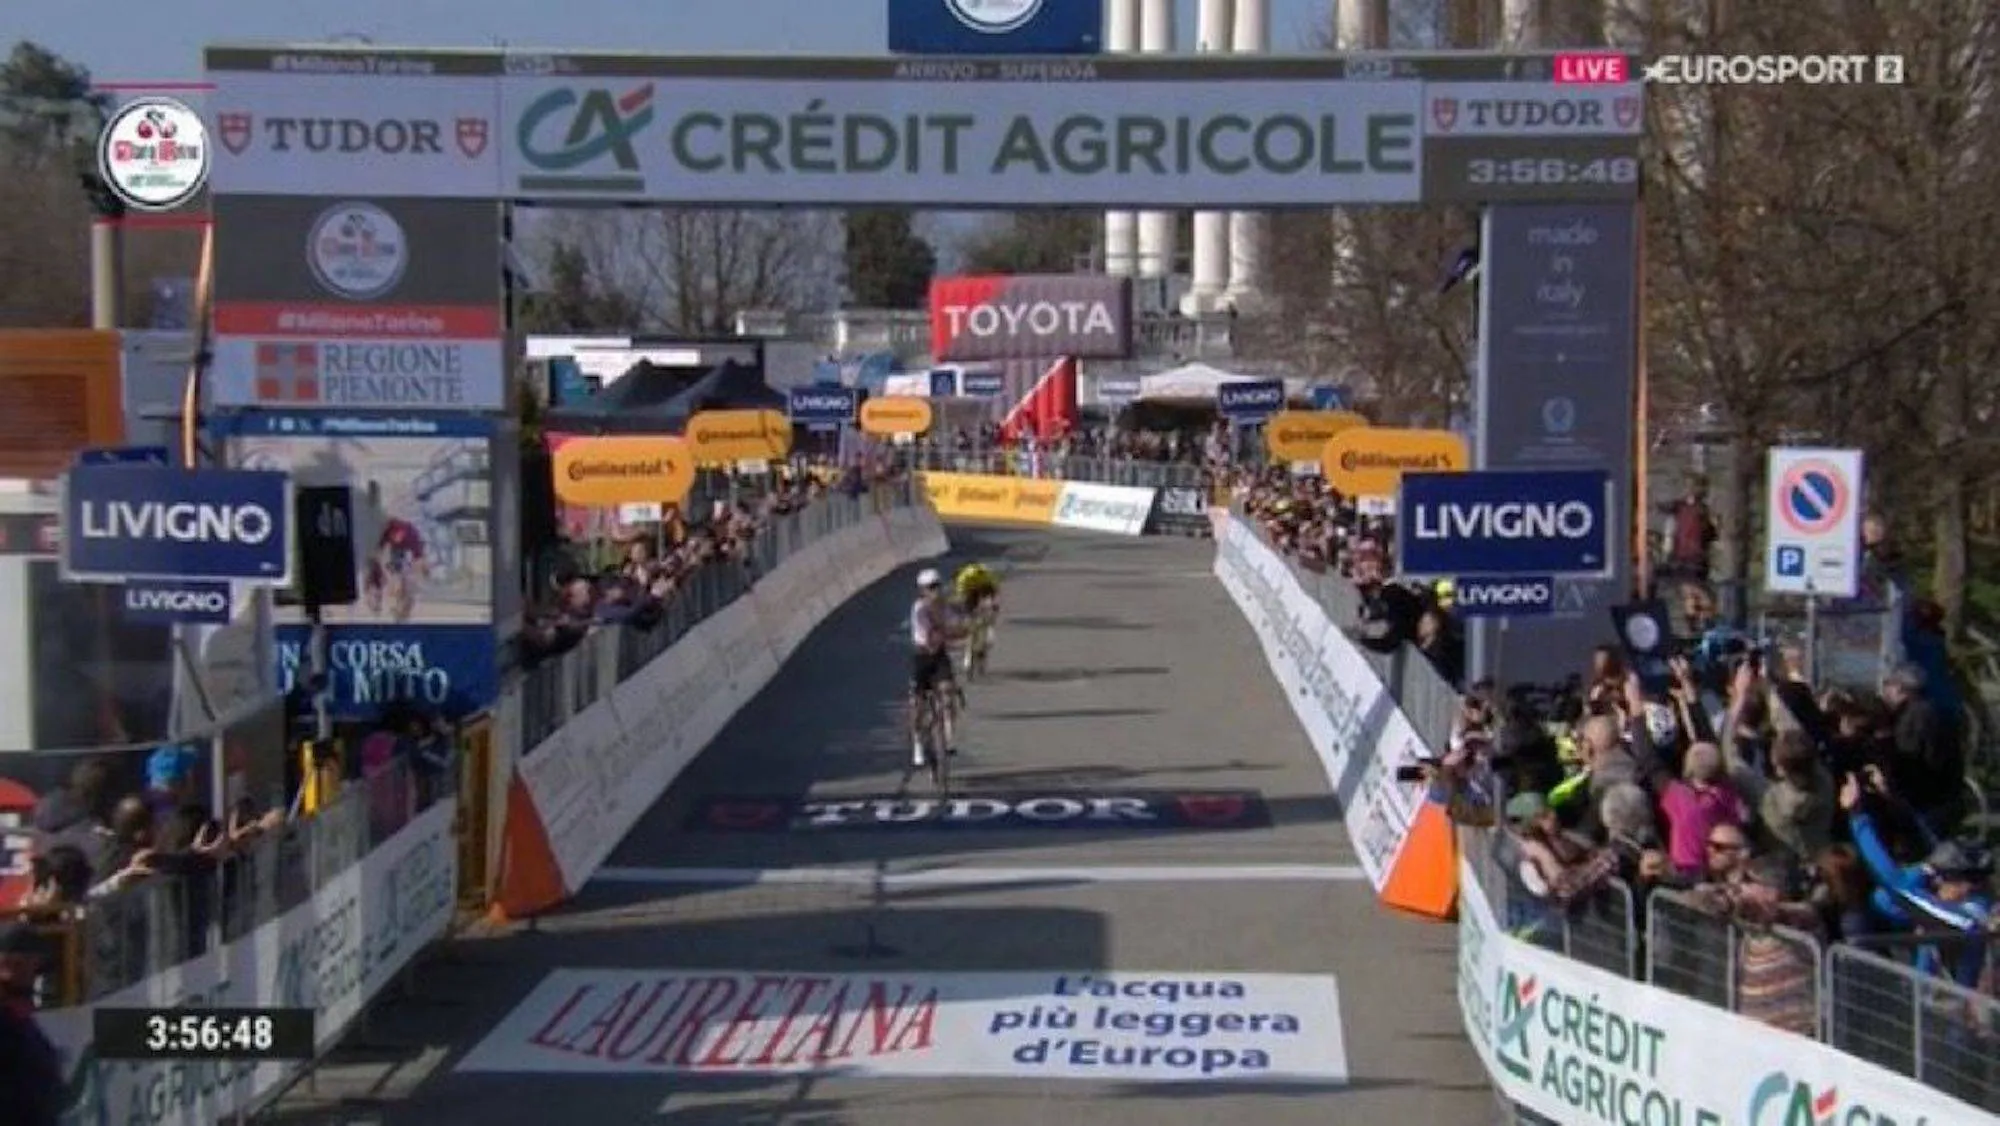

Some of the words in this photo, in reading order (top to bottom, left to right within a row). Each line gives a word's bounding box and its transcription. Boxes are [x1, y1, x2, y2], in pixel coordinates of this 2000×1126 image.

[1467, 99, 1604, 128] TUDOR
[265, 118, 442, 153] TUDOR
[670, 99, 974, 175] CRÉDIT
[991, 112, 1414, 175] AGRICOLE
[1468, 157, 1638, 184] 3:56:48
[1527, 219, 1599, 245] made
[943, 300, 1115, 338] TOYOTA
[324, 343, 462, 374] REGIONE
[325, 375, 463, 402] PIEMONTE
[1221, 385, 1282, 406] LIVIGNO
[81, 500, 273, 544] LIVIGNO
[1414, 500, 1594, 541] LIVIGNO
[126, 588, 225, 613] LIVIGNO
[1457, 582, 1550, 607] LIVIGNO
[331, 640, 424, 671] CORSA
[805, 796, 1157, 825] TUDOR
[1053, 975, 1246, 1003] L'acqua
[530, 974, 940, 1069] LAURETANA
[989, 1006, 1078, 1033] più
[1094, 1006, 1300, 1037] leggera
[1541, 986, 1666, 1079] CRÉDIT
[1012, 1040, 1270, 1074] d'Europa
